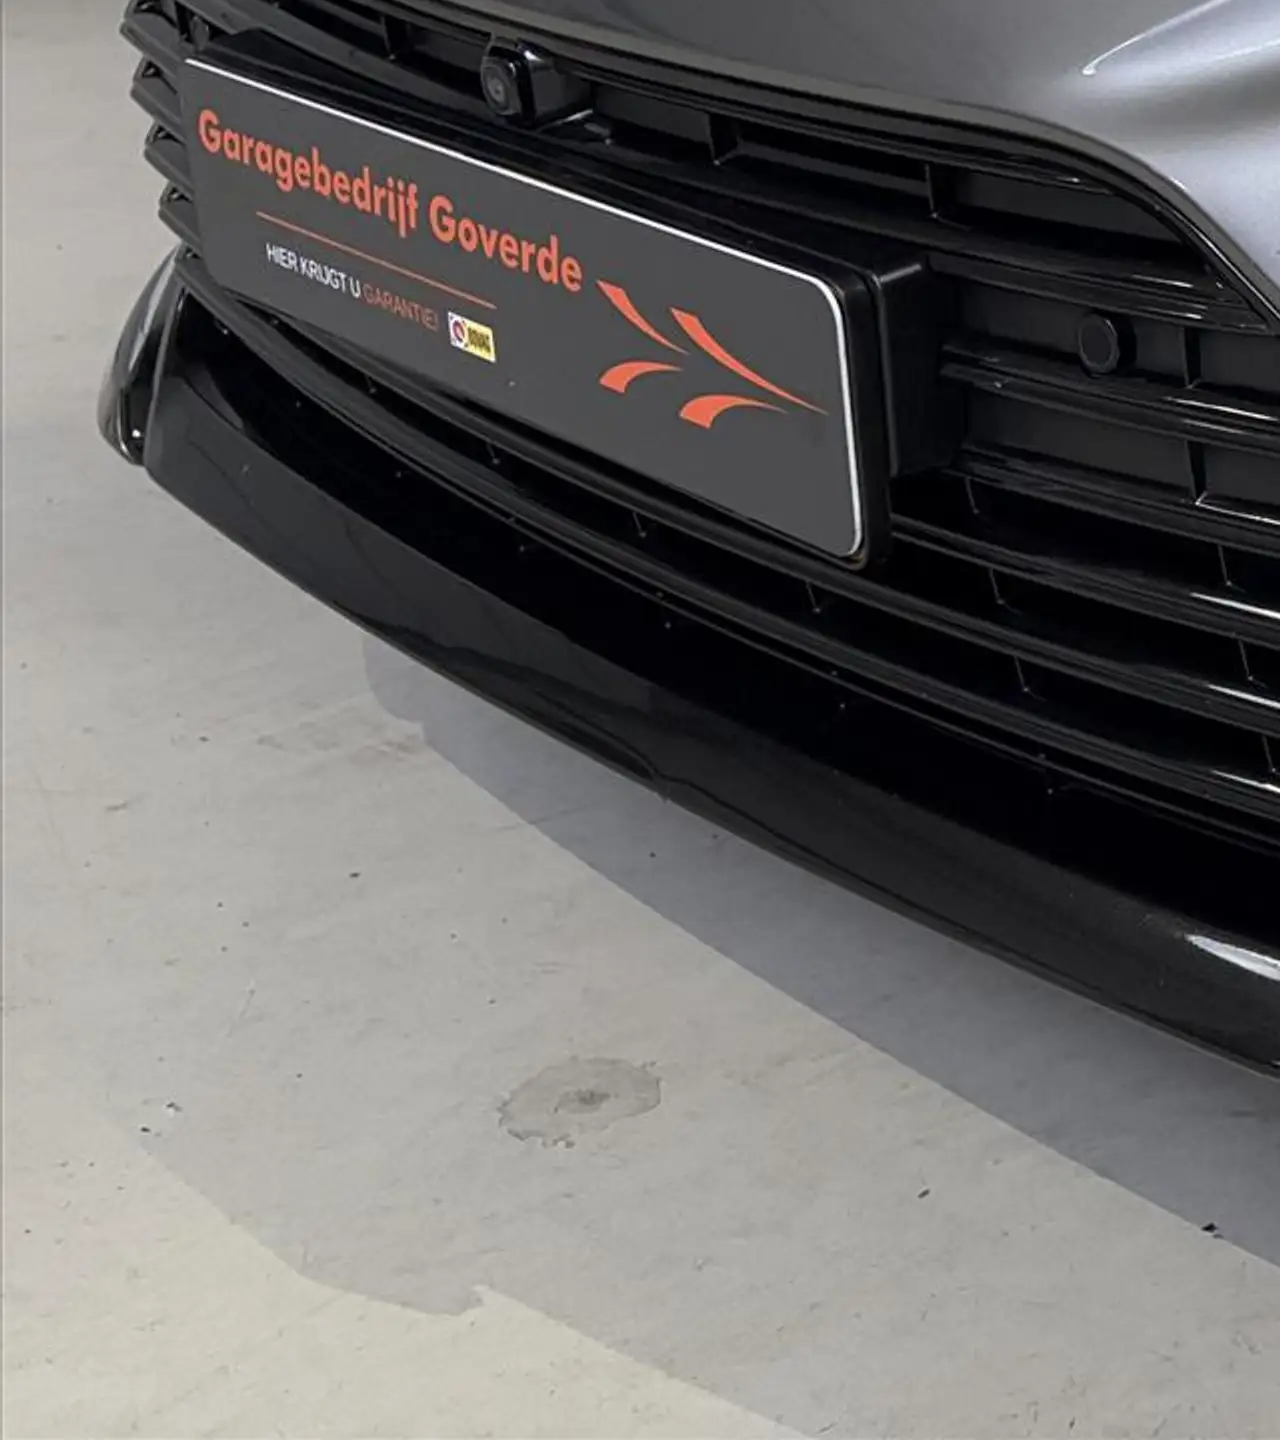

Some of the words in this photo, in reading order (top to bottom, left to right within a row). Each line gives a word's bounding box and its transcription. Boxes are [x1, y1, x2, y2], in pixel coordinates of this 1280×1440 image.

[199, 109, 418, 237] Garagebedrijf
[428, 194, 582, 292] Goverde
[265, 242, 299, 271] HIER
[300, 256, 347, 293] KRIJGT
[350, 277, 362, 299] U
